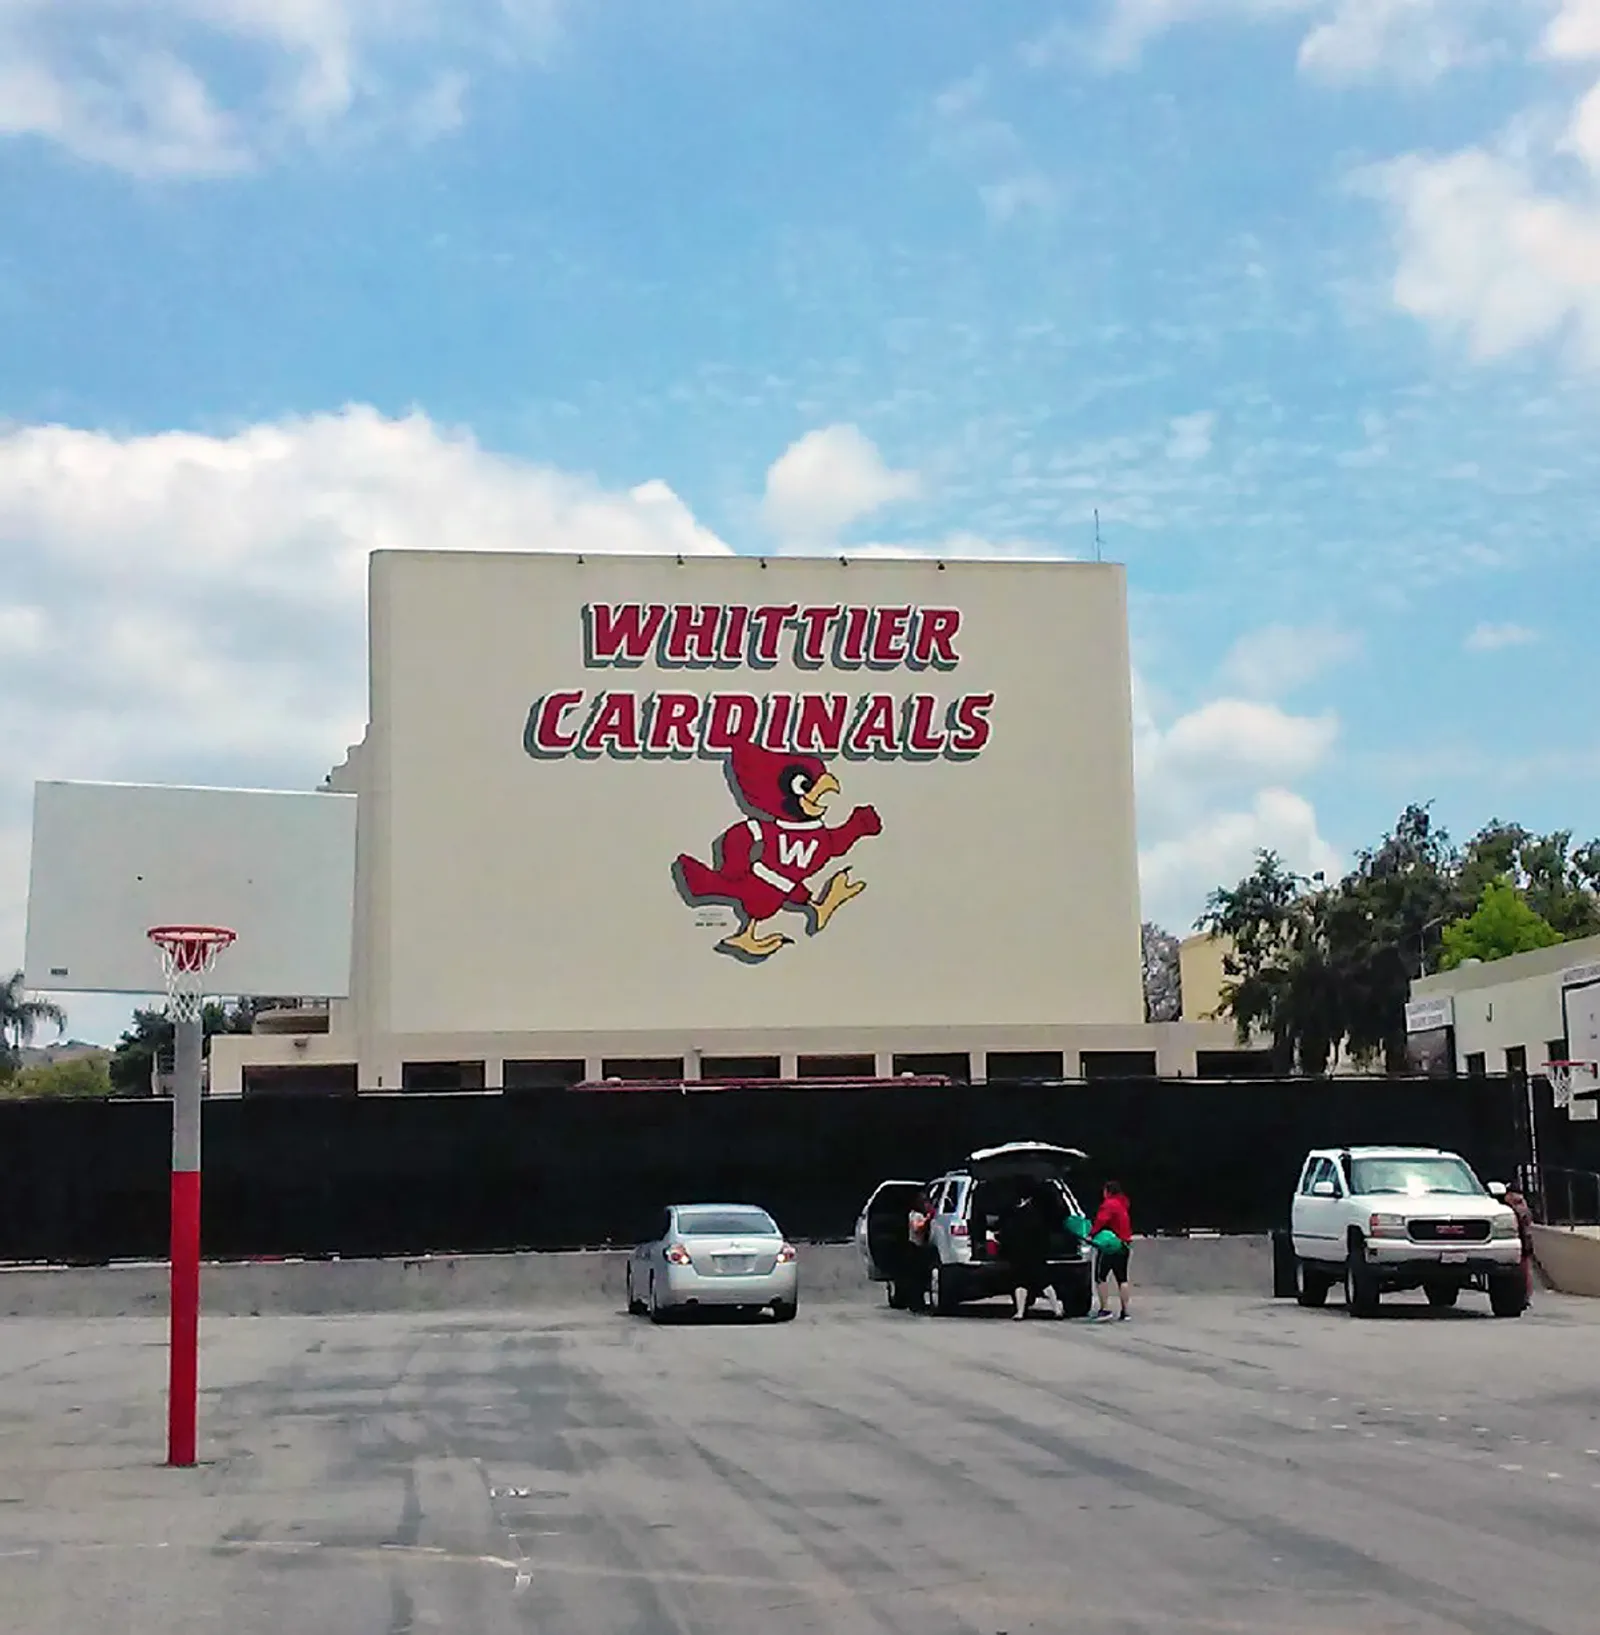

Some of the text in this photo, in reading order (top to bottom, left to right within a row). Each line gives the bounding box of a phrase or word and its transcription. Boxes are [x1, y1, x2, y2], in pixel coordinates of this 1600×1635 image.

[582, 602, 962, 670] WHITTIER
[524, 690, 995, 761] CARDINALS
[779, 835, 816, 869] W
